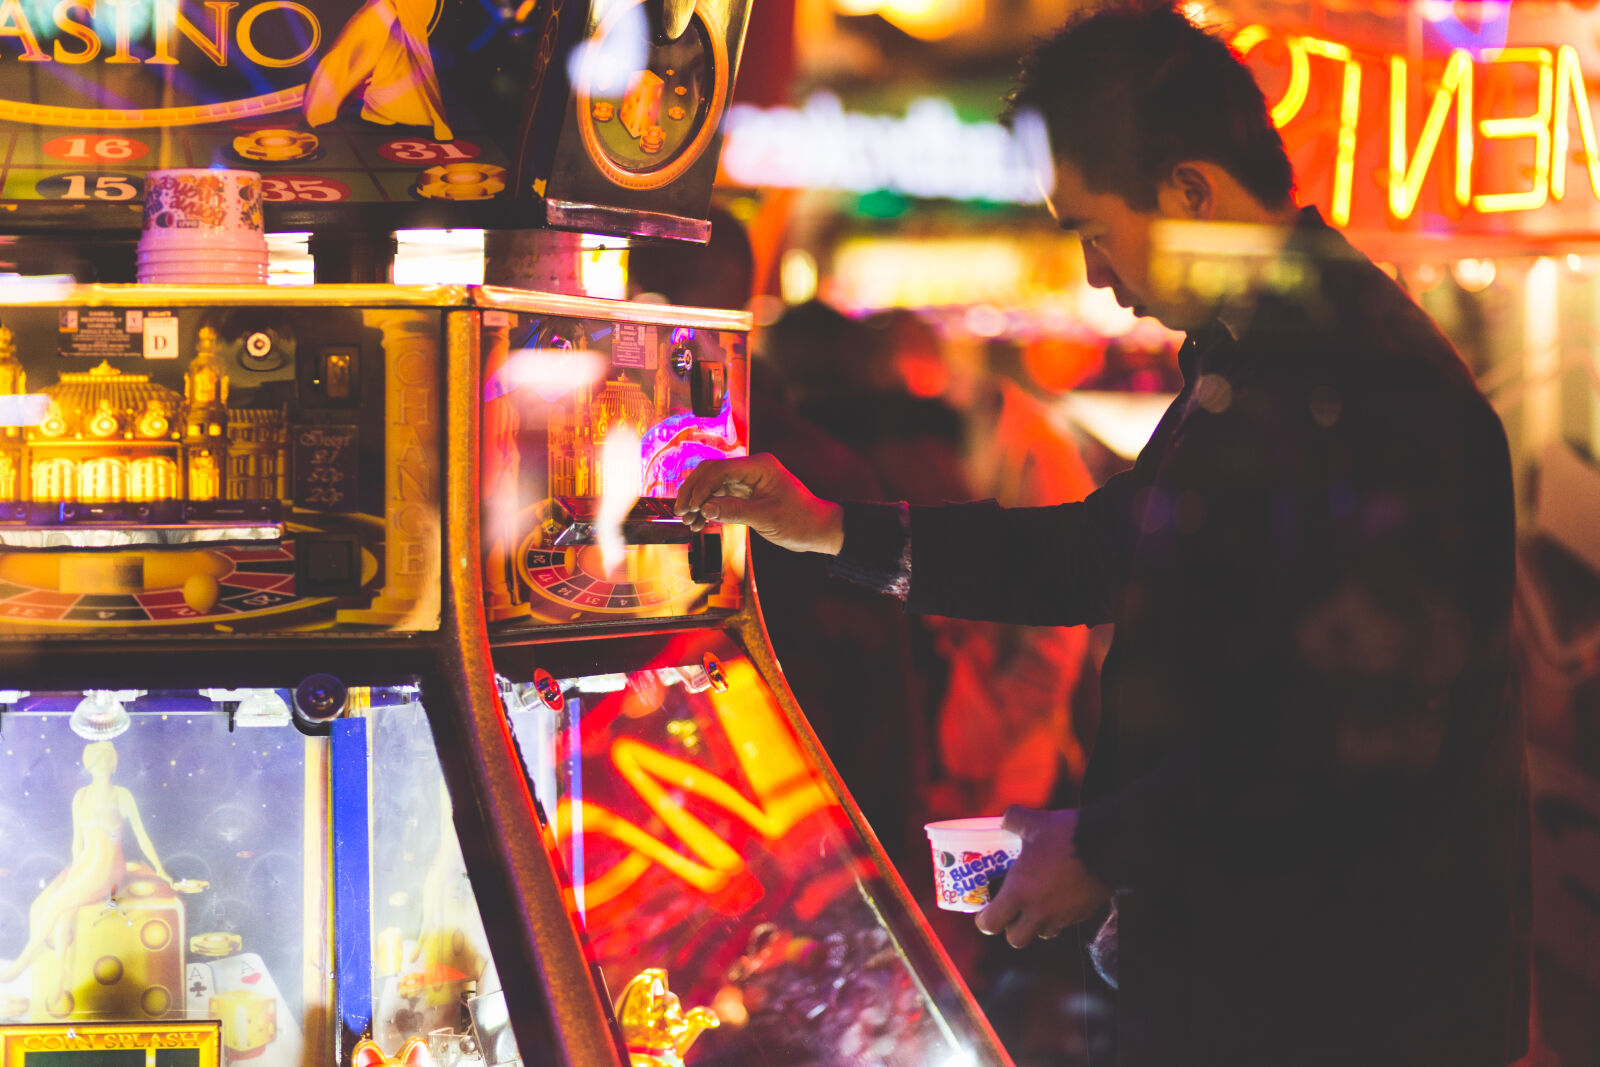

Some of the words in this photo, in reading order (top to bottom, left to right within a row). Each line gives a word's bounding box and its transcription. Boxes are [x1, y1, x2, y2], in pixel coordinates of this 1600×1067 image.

[62, 139, 132, 158] 16
[390, 140, 469, 160] 31
[62, 175, 137, 200] 15
[261, 179, 342, 202] 35
[153, 335, 168, 350] D
[949, 850, 1010, 882] Buena
[24, 1034, 97, 1050] COIN
[104, 1032, 200, 1049] SPLASH
